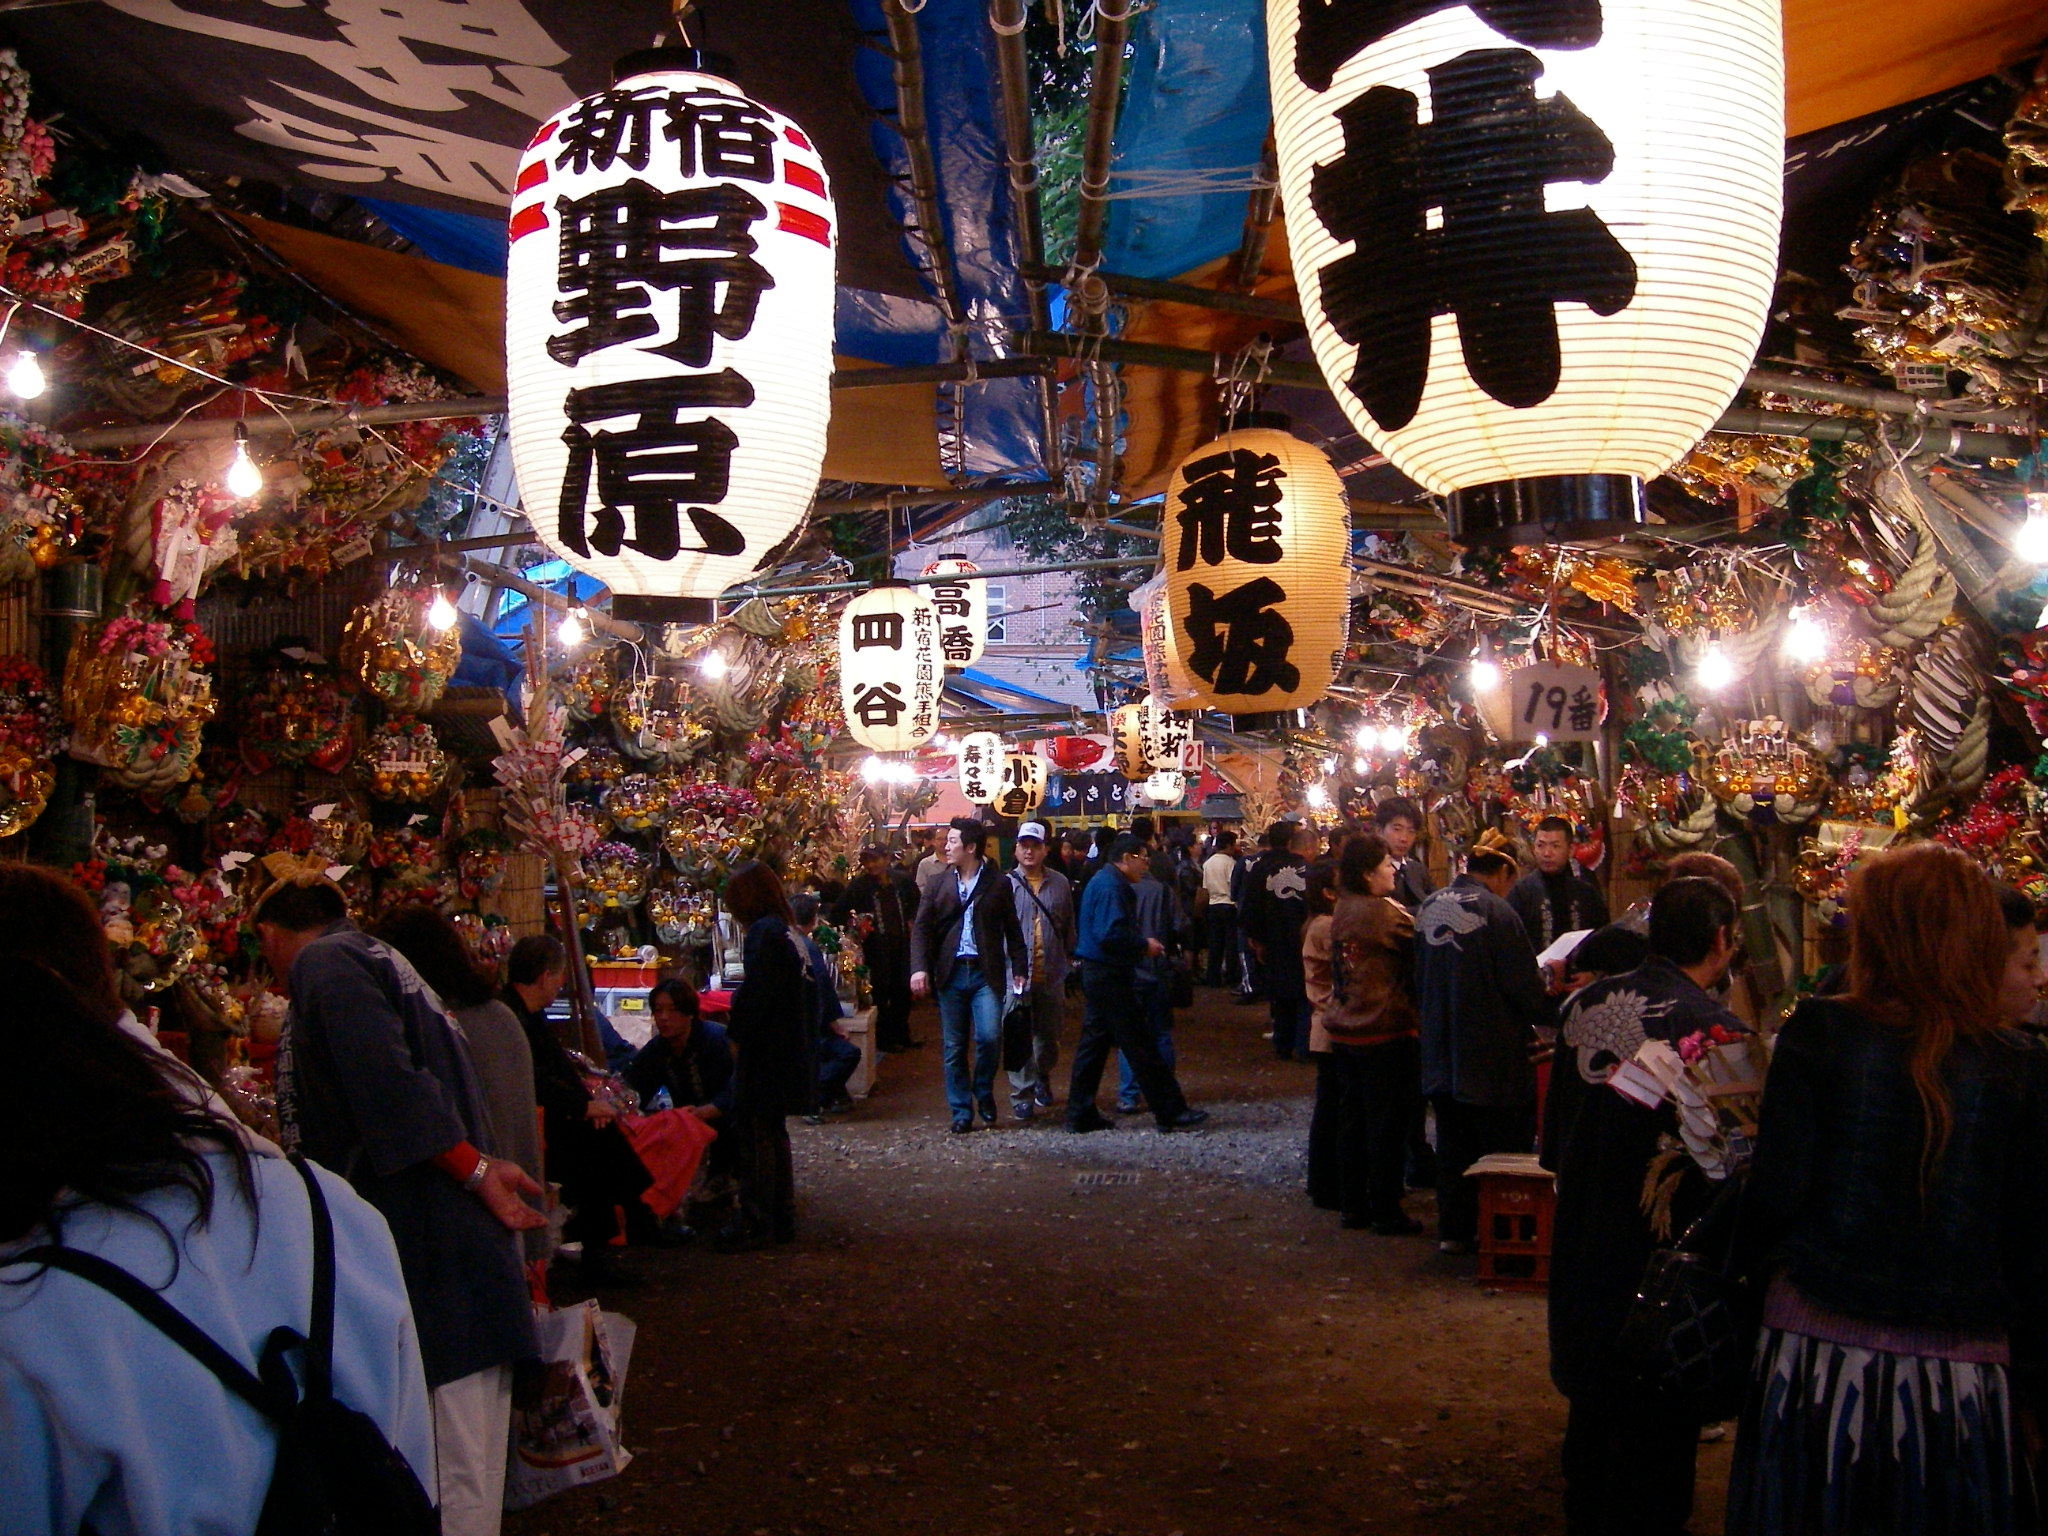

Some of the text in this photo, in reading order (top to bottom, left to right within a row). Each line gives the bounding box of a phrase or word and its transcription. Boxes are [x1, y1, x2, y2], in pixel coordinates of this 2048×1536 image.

[555, 87, 778, 184] 新宿
[546, 177, 776, 561] 野原
[852, 612, 907, 728] 四谷
[1524, 681, 1597, 731] 19番
[1002, 758, 1029, 814] 小倉
[1184, 744, 1202, 767] 21
